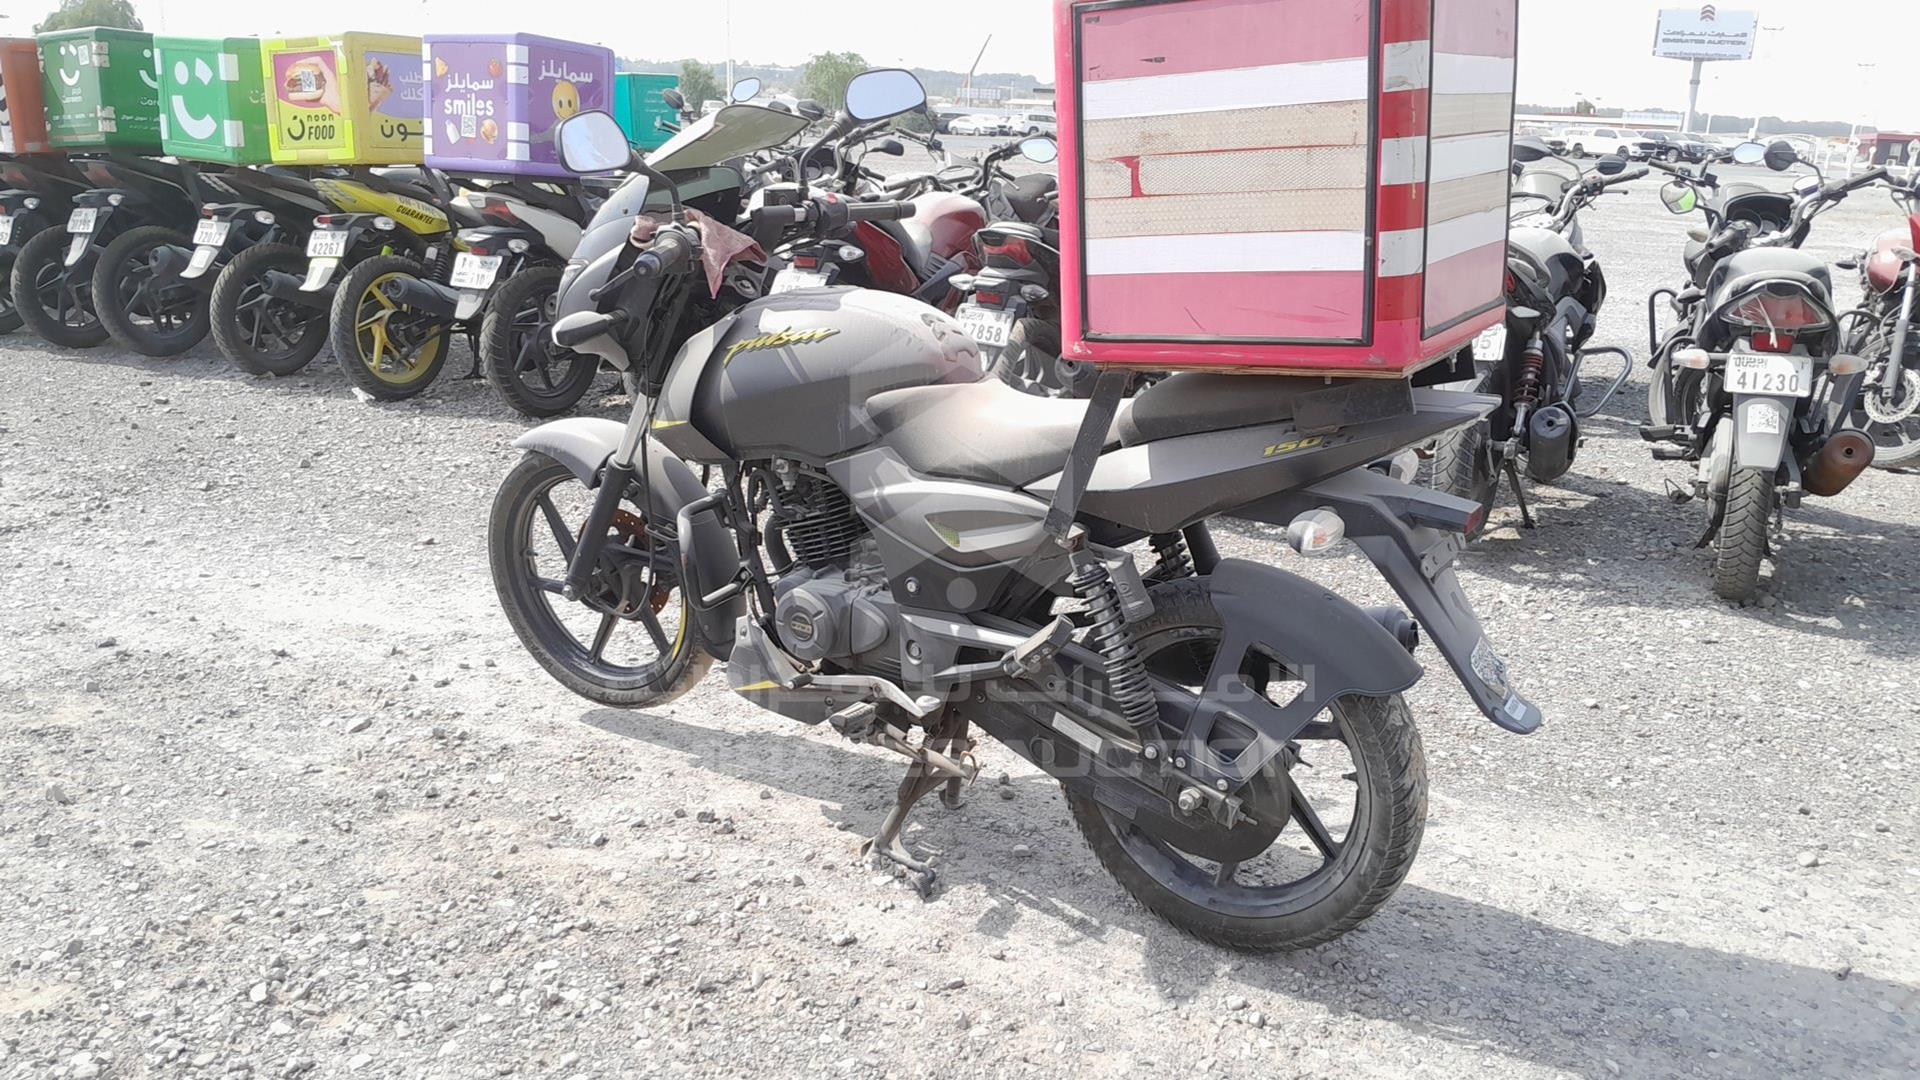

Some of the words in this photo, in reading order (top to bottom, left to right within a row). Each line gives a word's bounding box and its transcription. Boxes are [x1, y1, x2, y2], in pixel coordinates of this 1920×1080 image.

[538, 59, 593, 83] سمايلز
[445, 72, 494, 93] سمايلز
[444, 92, 495, 117] smiles
[307, 113, 335, 122] noon
[308, 125, 335, 141] FOOD
[312, 242, 340, 255] 42267
[1736, 371, 1800, 393] 41230
[1263, 436, 1325, 457] 150
